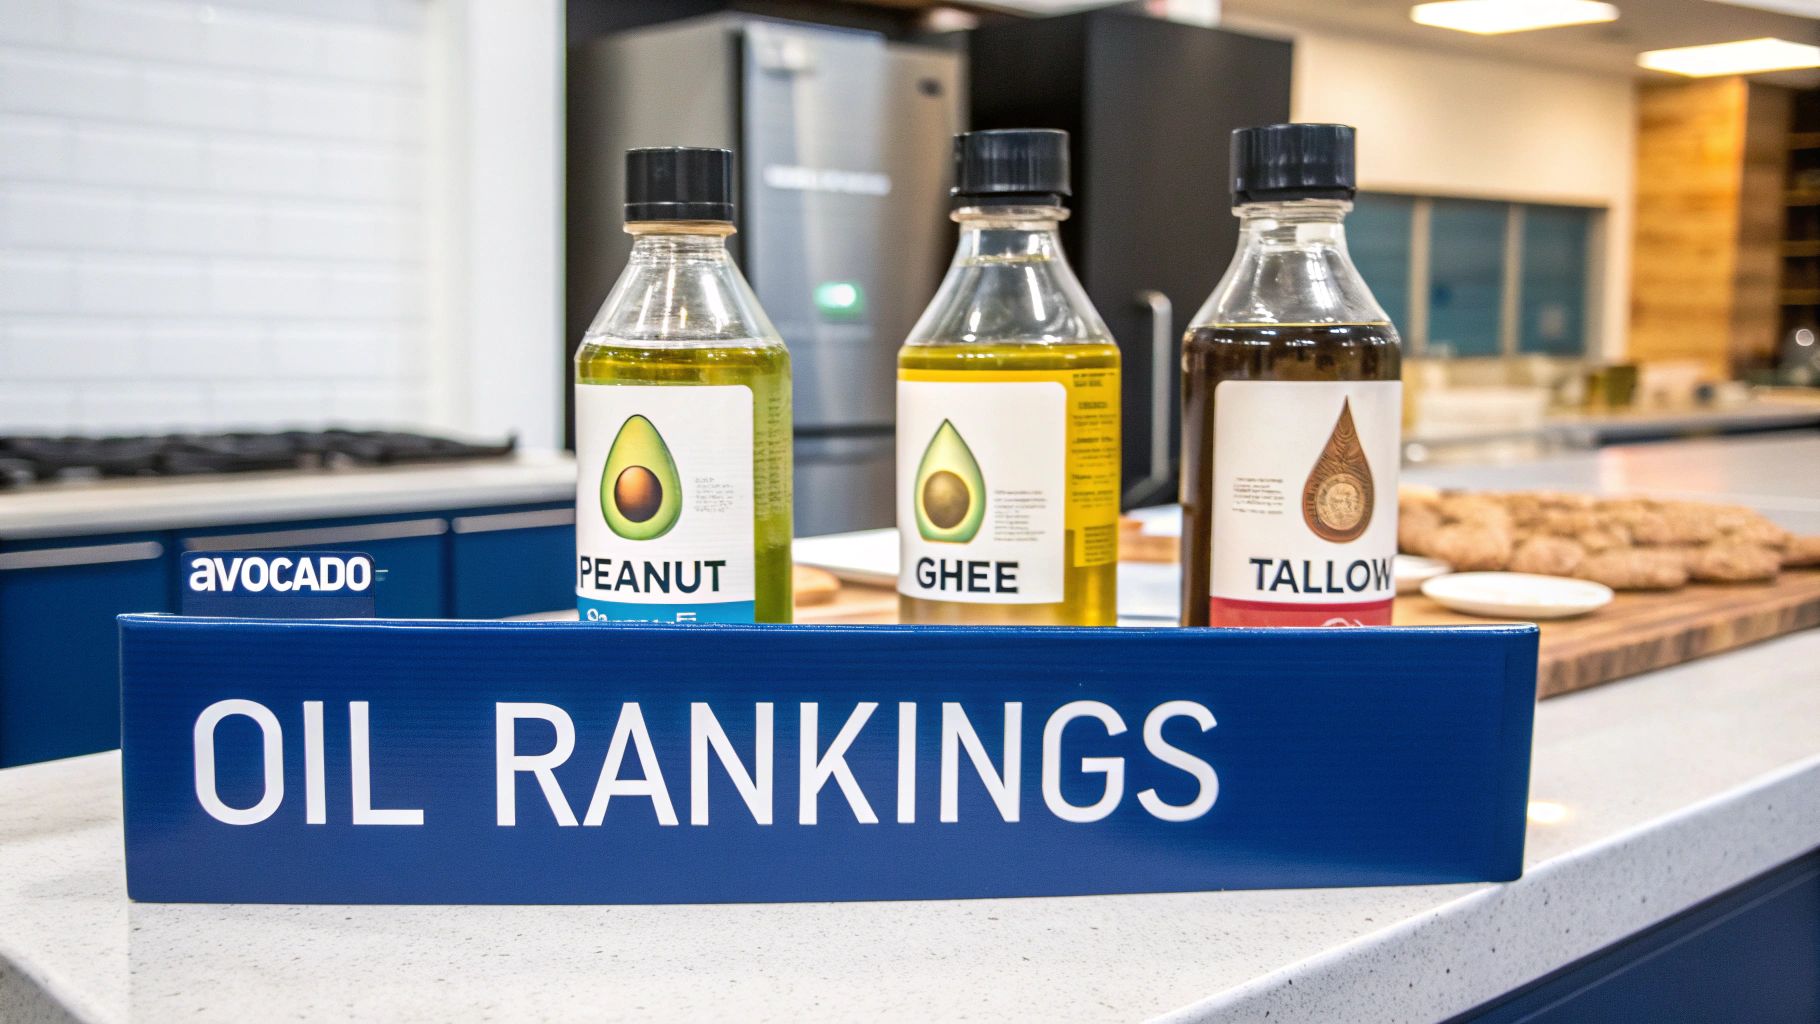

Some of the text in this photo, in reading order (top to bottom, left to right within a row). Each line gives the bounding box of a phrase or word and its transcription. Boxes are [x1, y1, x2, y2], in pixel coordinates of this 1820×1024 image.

[580, 556, 726, 594] PEANUT
[916, 557, 1019, 594] GHEE
[1249, 557, 1393, 594] TALLOW
[193, 698, 1220, 827] OIL RANKINGS
